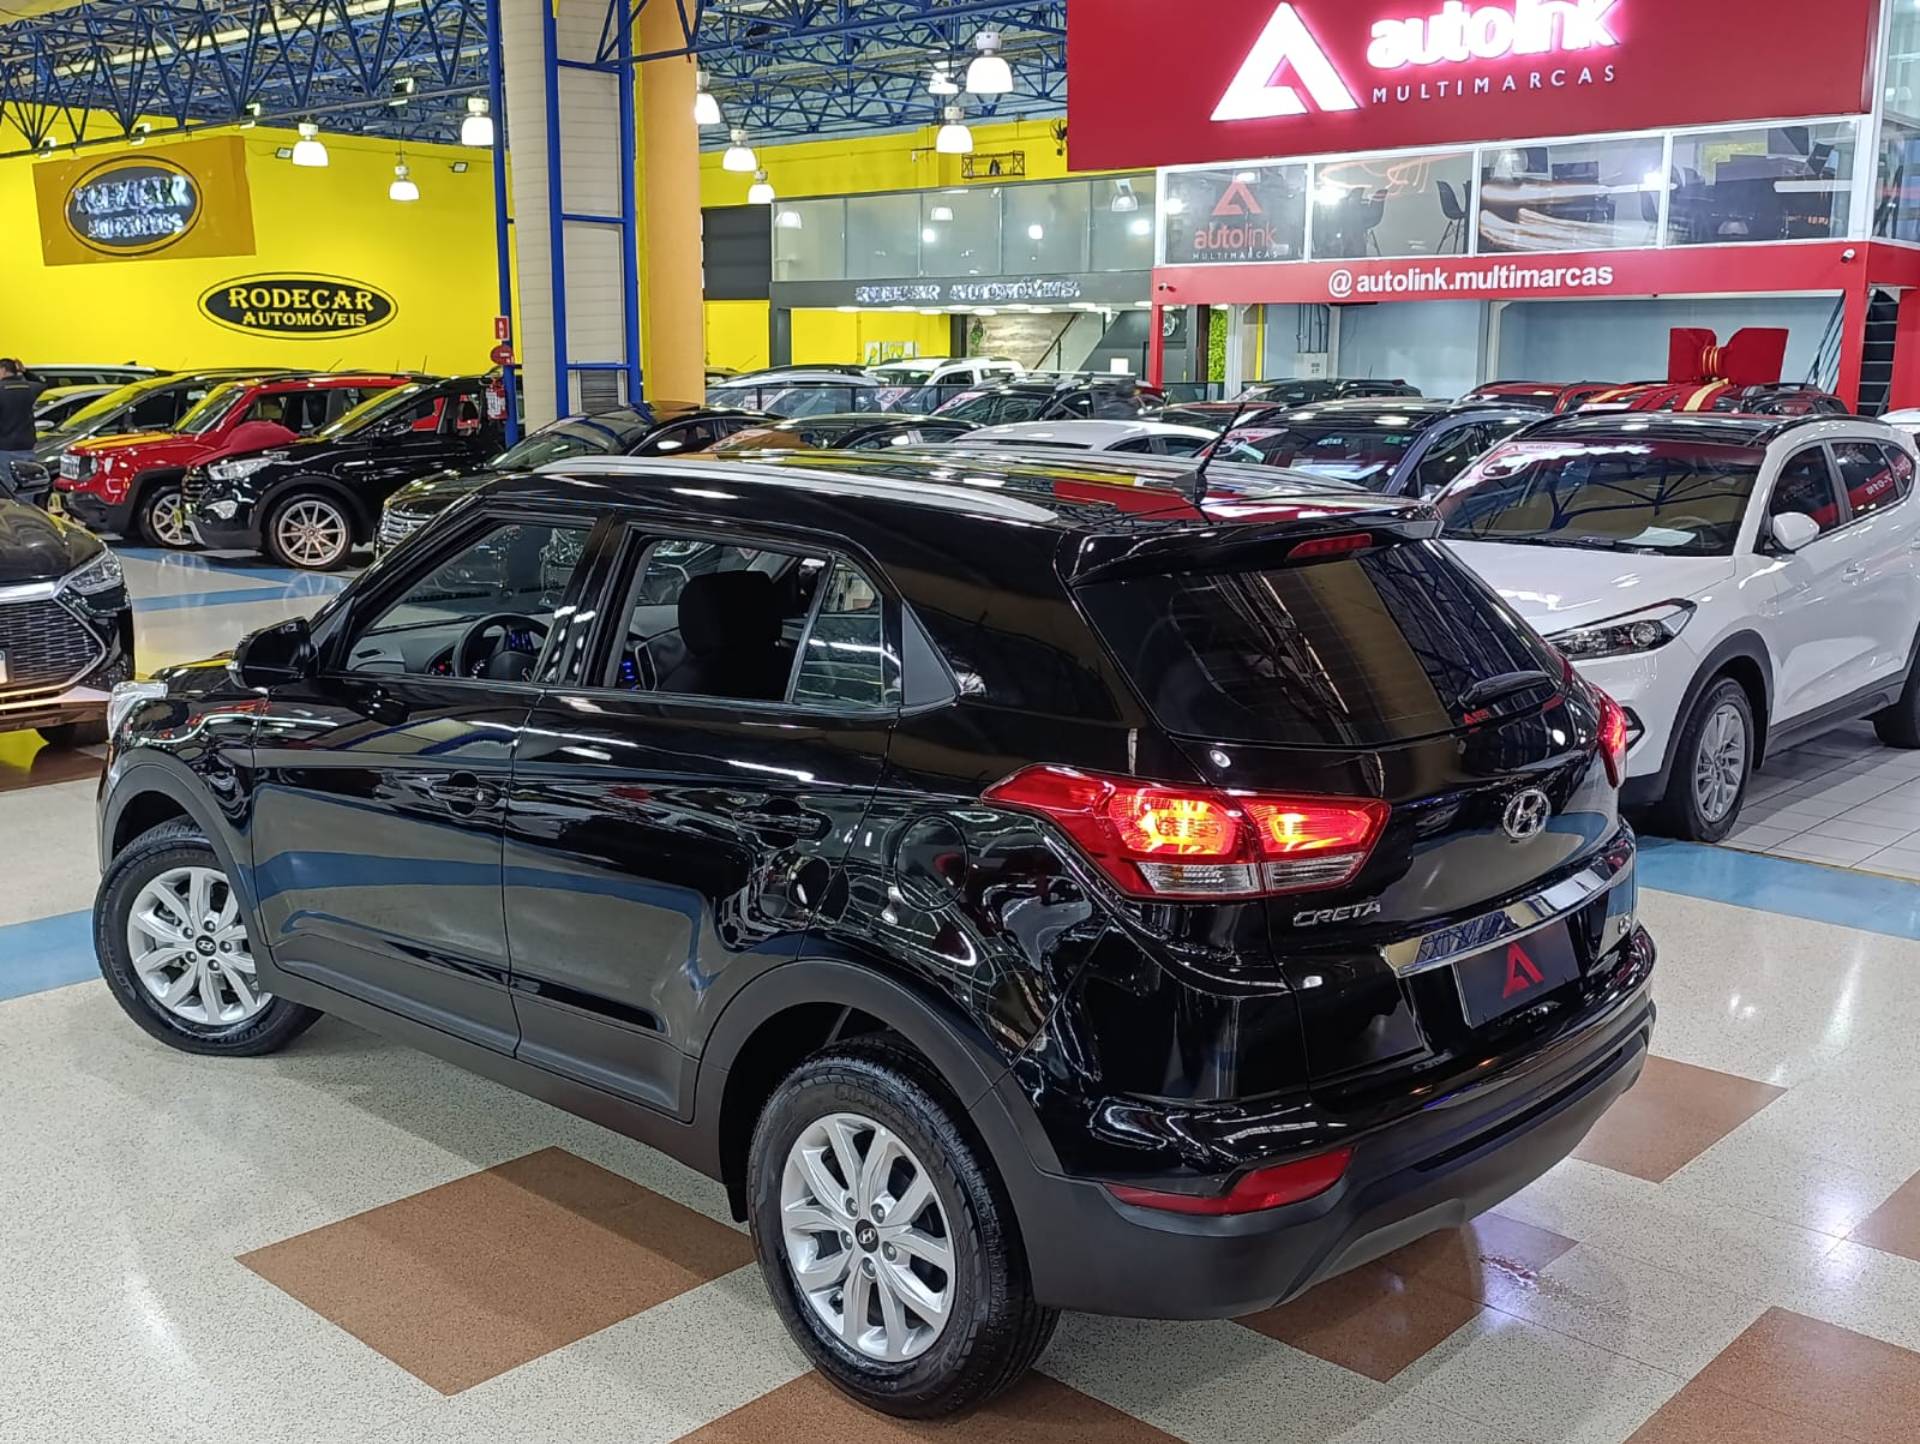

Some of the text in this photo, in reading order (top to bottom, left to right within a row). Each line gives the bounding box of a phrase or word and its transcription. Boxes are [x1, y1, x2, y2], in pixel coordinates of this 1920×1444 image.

[1367, 0, 1619, 69] autolink
[1373, 64, 1615, 104] MULTIMARCAS
[1193, 222, 1277, 249] autolink
[228, 287, 374, 311] RODECAR
[242, 310, 367, 326] AUTOMÓVEIS
[1293, 901, 1381, 926] CRETA
